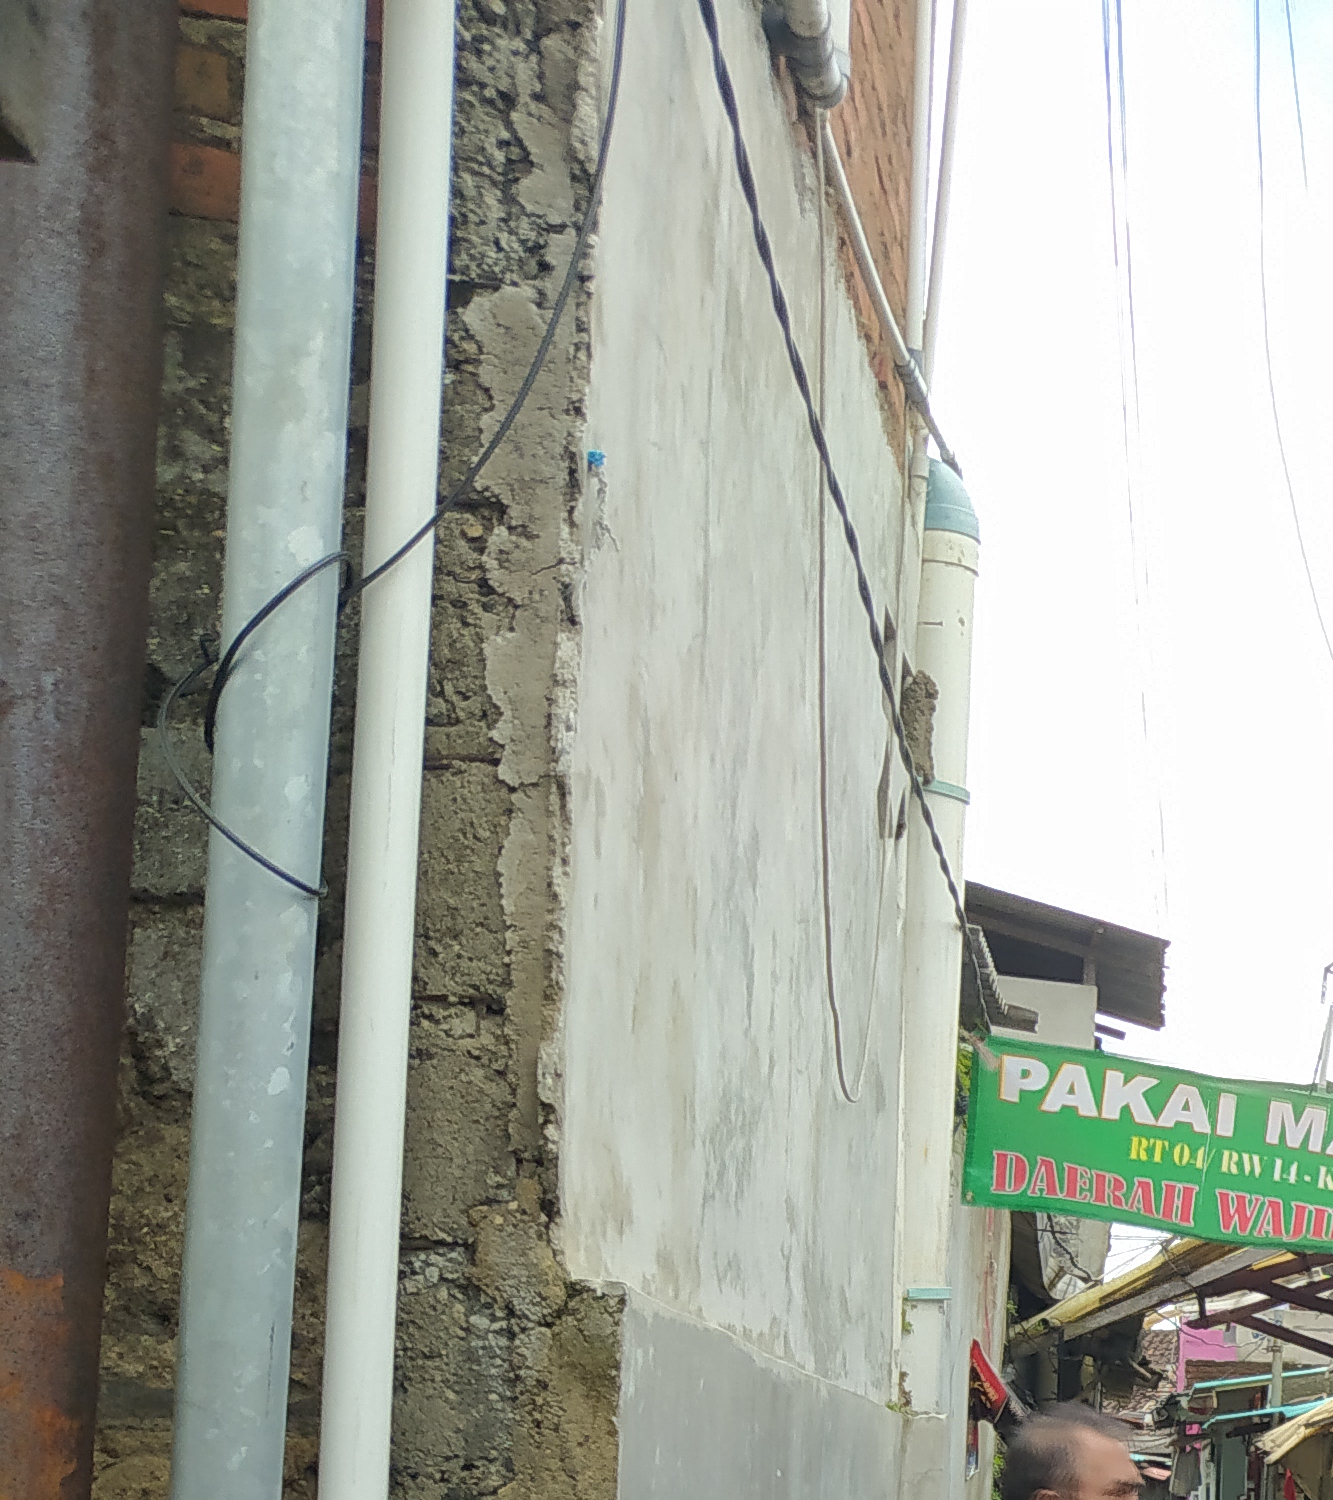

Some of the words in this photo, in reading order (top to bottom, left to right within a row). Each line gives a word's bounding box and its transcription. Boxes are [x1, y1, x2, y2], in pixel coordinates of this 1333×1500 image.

[999, 1054, 1238, 1138] PAKAI
[990, 1150, 1199, 1227] DAERAH
[1129, 1135, 1169, 1164] RT
[1220, 1148, 1268, 1179] RW
